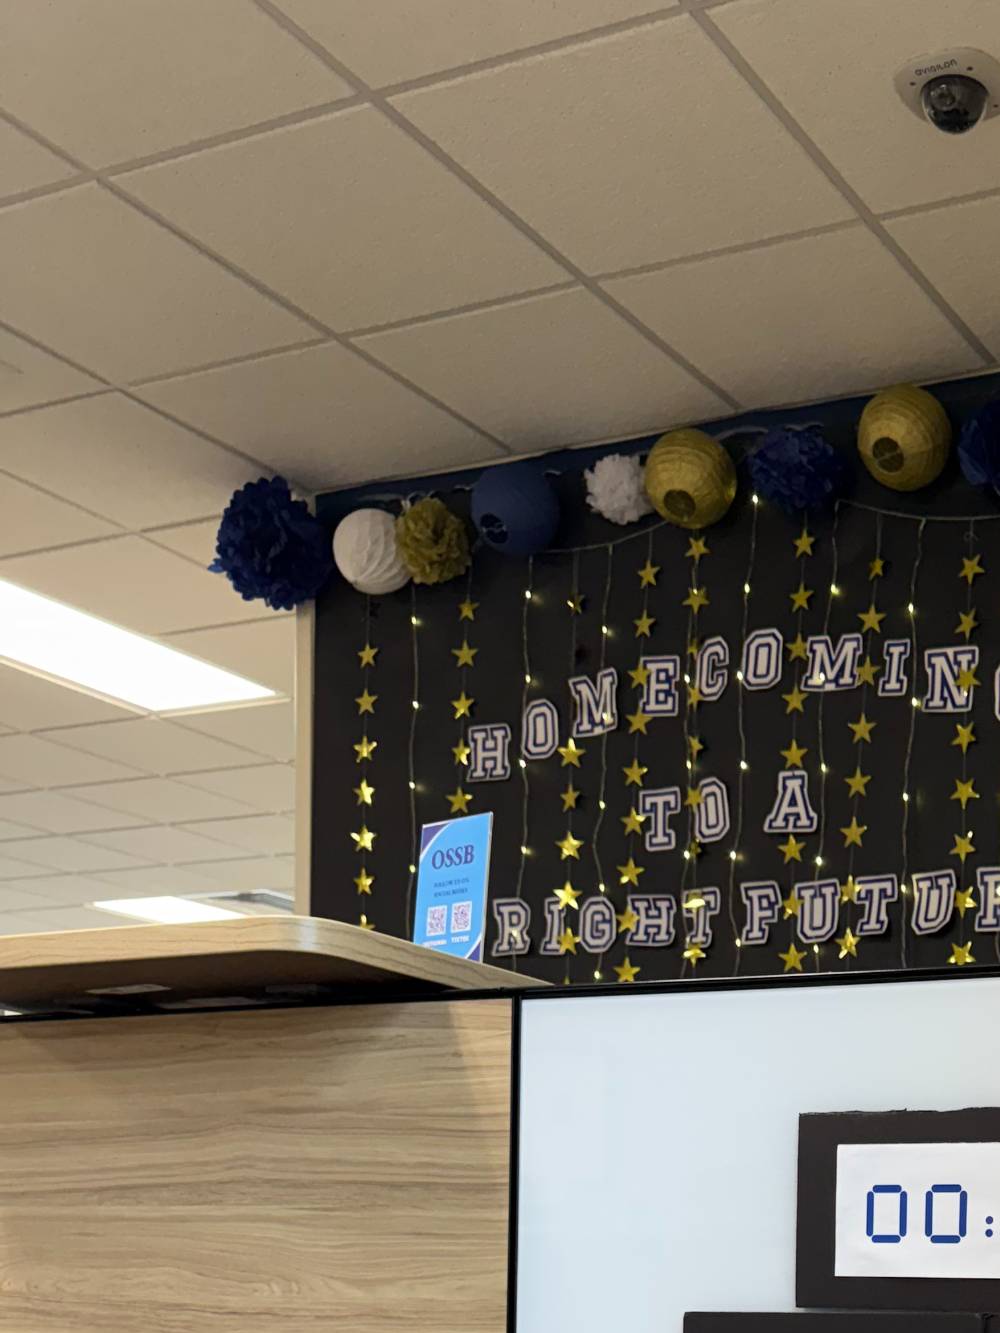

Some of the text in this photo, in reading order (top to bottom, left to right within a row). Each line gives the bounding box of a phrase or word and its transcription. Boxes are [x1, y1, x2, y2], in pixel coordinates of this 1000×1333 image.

[638, 769, 818, 852] TO A
[431, 844, 475, 870] OSSB
